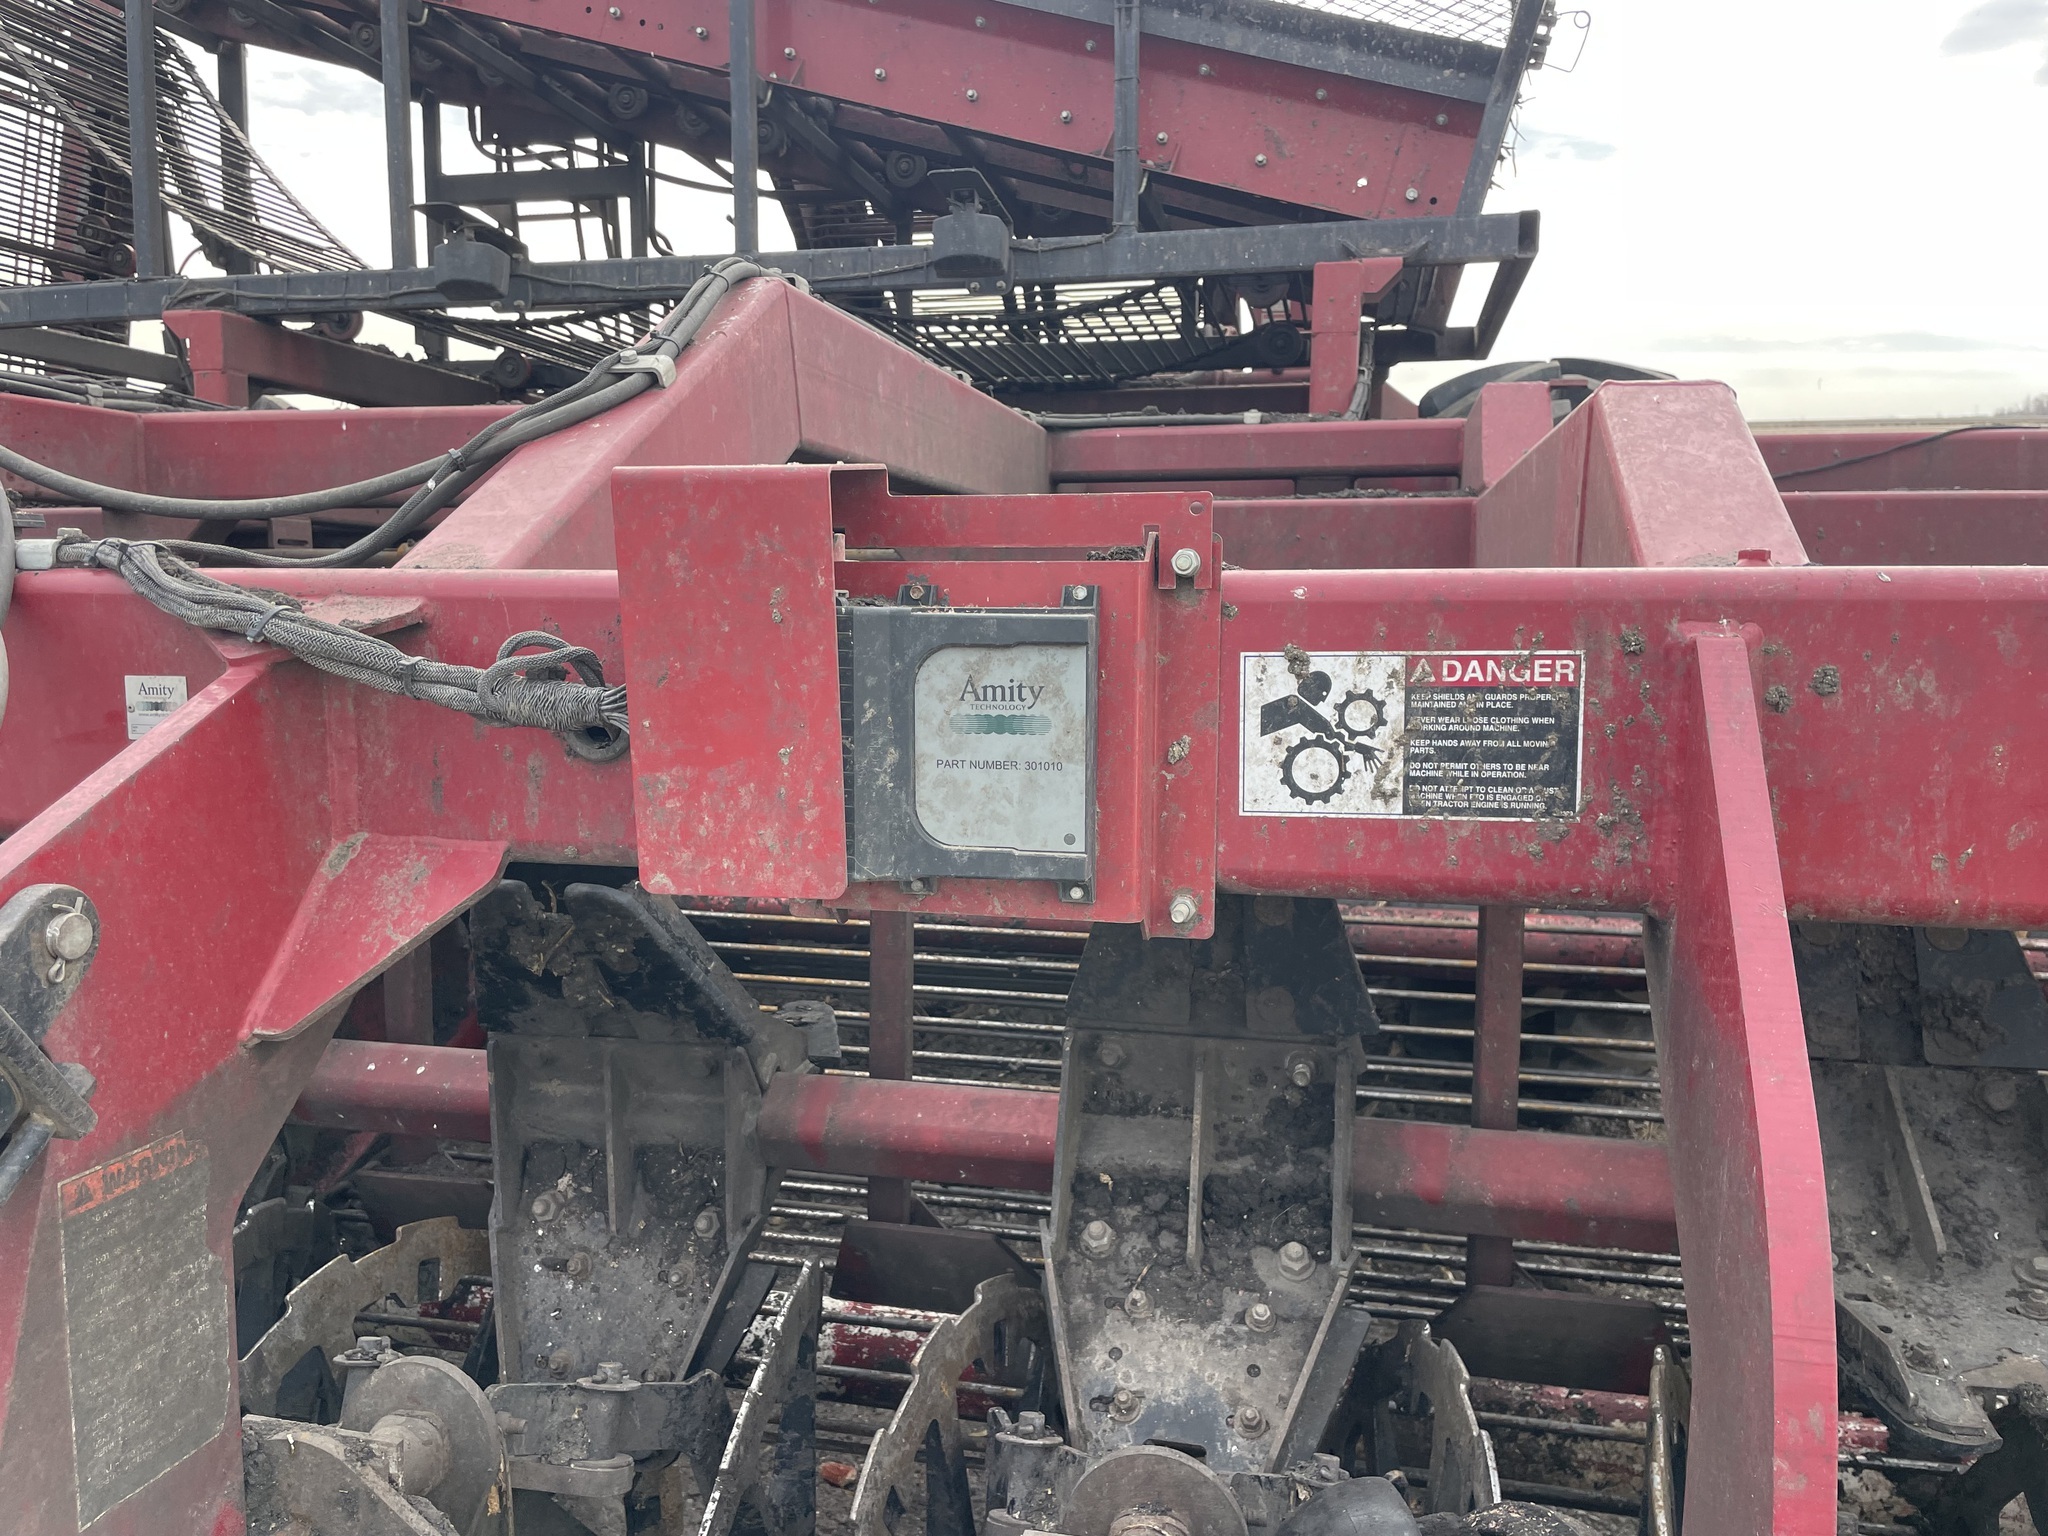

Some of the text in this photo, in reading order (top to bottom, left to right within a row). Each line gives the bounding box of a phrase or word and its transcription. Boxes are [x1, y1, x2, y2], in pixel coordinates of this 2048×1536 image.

[1442, 659, 1575, 683] DANGER
[138, 682, 174, 699] Amity
[959, 674, 1045, 709] Amity
[1411, 693, 1431, 701] KEEP
[1433, 693, 1465, 701] SHIELDS
[1467, 693, 1482, 701] AN
[1485, 693, 1517, 701] GUARDS
[970, 703, 1026, 711] TECHNOLOGY
[1476, 701, 1484, 709] IN
[1486, 701, 1513, 709] PLACE.
[1411, 716, 1435, 724] EVER
[1438, 716, 1460, 724] WEAR
[1463, 716, 1488, 724] LOSE
[1490, 716, 1529, 724] CLOTHING
[1483, 724, 1520, 732] MACHINE.
[1432, 739, 1458, 747] HANDS
[1460, 739, 1481, 747] AWAY
[1483, 739, 1505, 747] FROM
[936, 759, 1063, 771] PART NUMBER: 301010
[1528, 763, 1549, 771] NEAR
[1409, 769, 1443, 777] MACHINE
[1501, 801, 1508, 809] IS
[1511, 802, 1547, 810] RUNNING.
[102, 1142, 207, 1195] WARNIN
